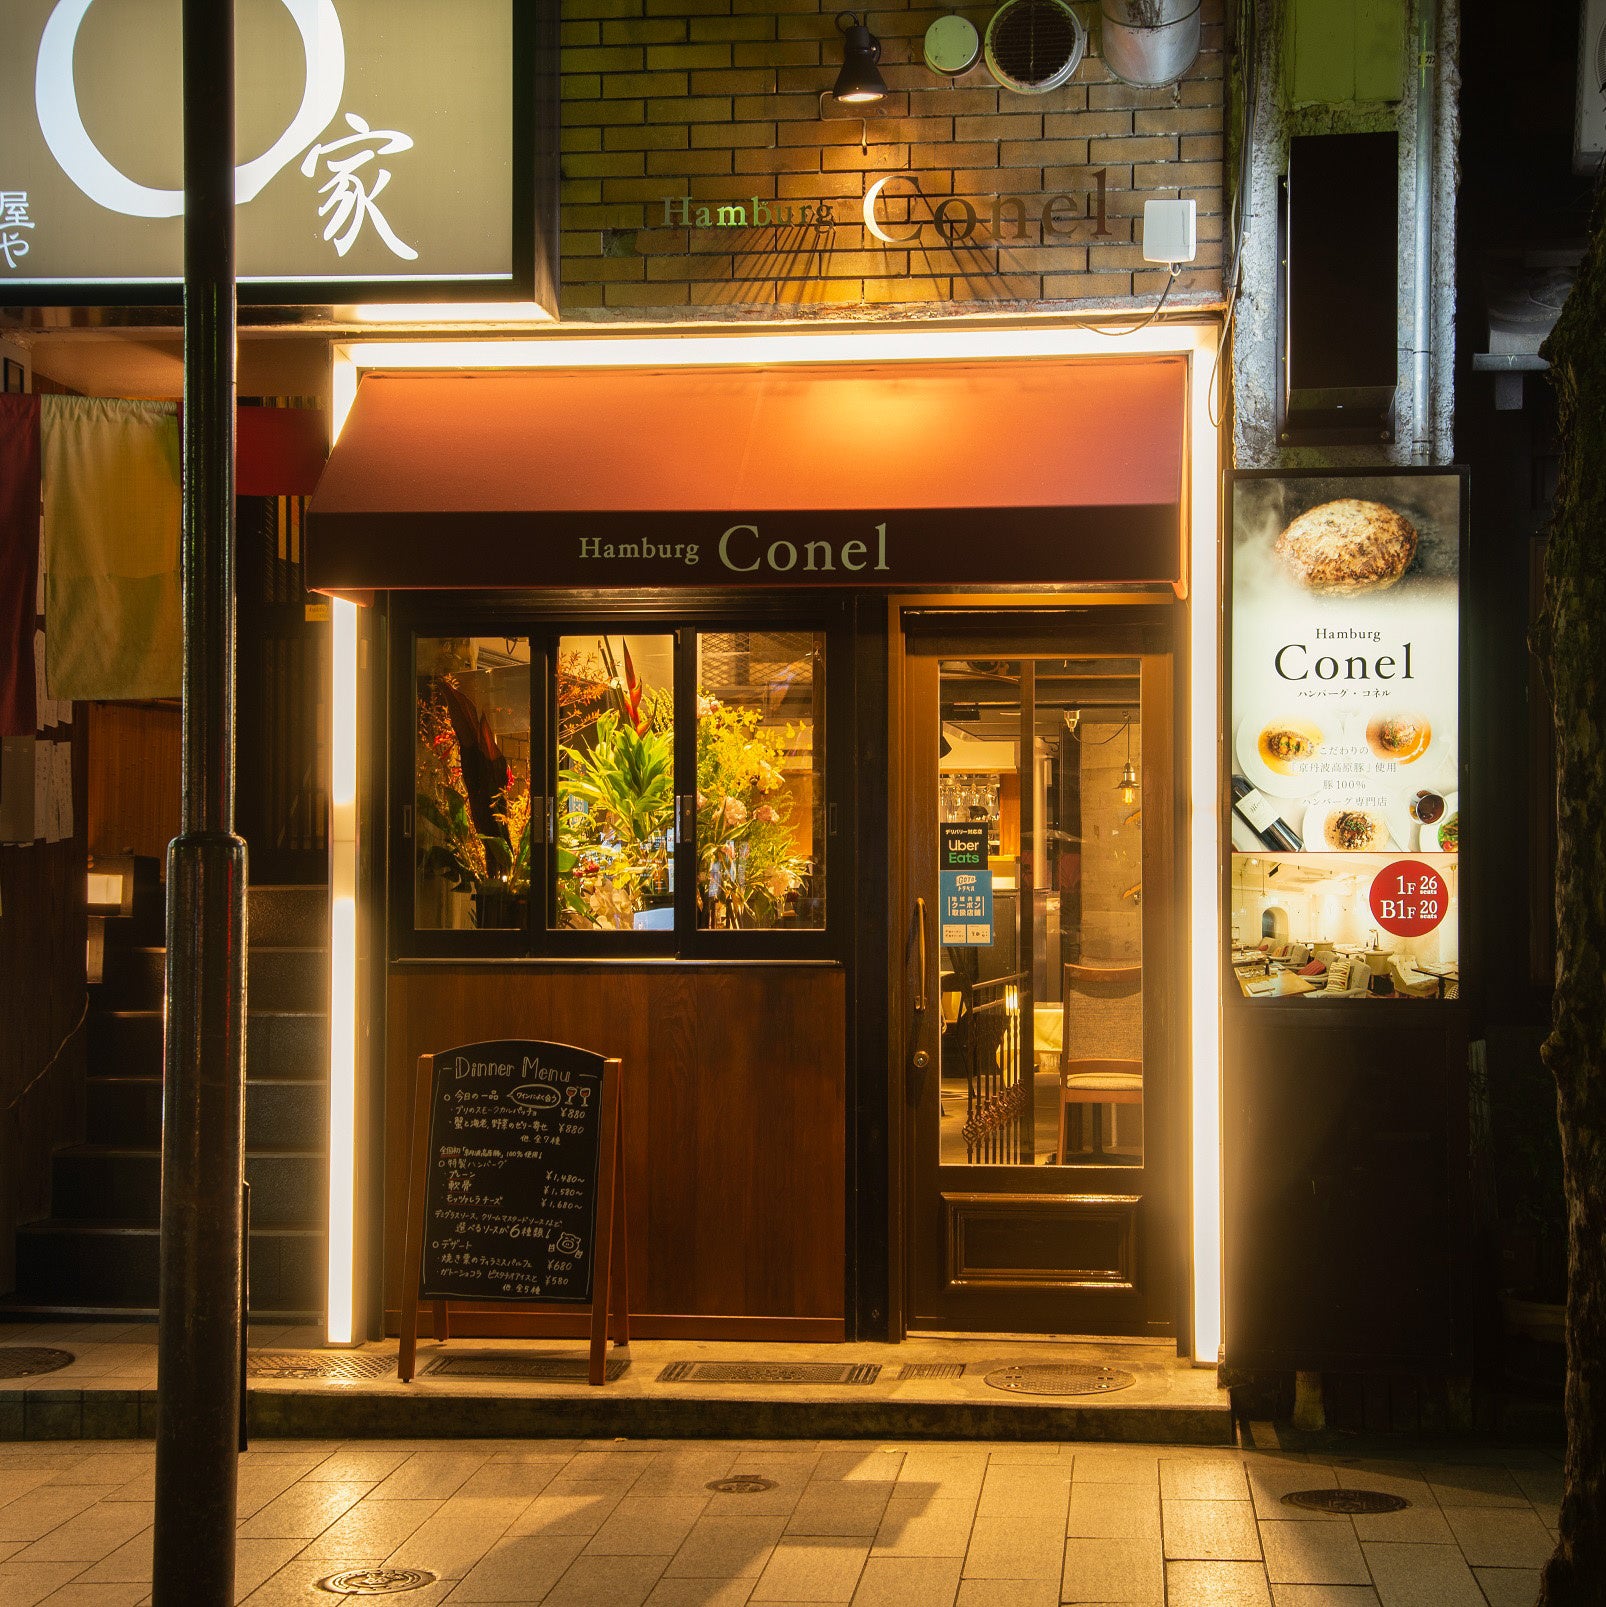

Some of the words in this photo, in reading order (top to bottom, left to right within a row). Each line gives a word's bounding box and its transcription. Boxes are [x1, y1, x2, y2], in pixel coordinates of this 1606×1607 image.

[300, 112, 418, 260] 家
[661, 195, 835, 234] Hamburg
[863, 168, 1112, 244] Conel
[578, 536, 700, 565] Hamburg
[718, 523, 890, 572] Conel
[1315, 628, 1381, 642] Hamburg
[1274, 642, 1414, 681] Conel
[948, 839, 979, 851] Uber
[948, 852, 980, 864] Eats
[1396, 875, 1416, 895] 1F
[1420, 876, 1438, 890] 26
[1380, 900, 1416, 919] B1F
[1420, 900, 1438, 914] 20
[455, 1056, 515, 1079] Dinner
[521, 1057, 571, 1082] Menu
